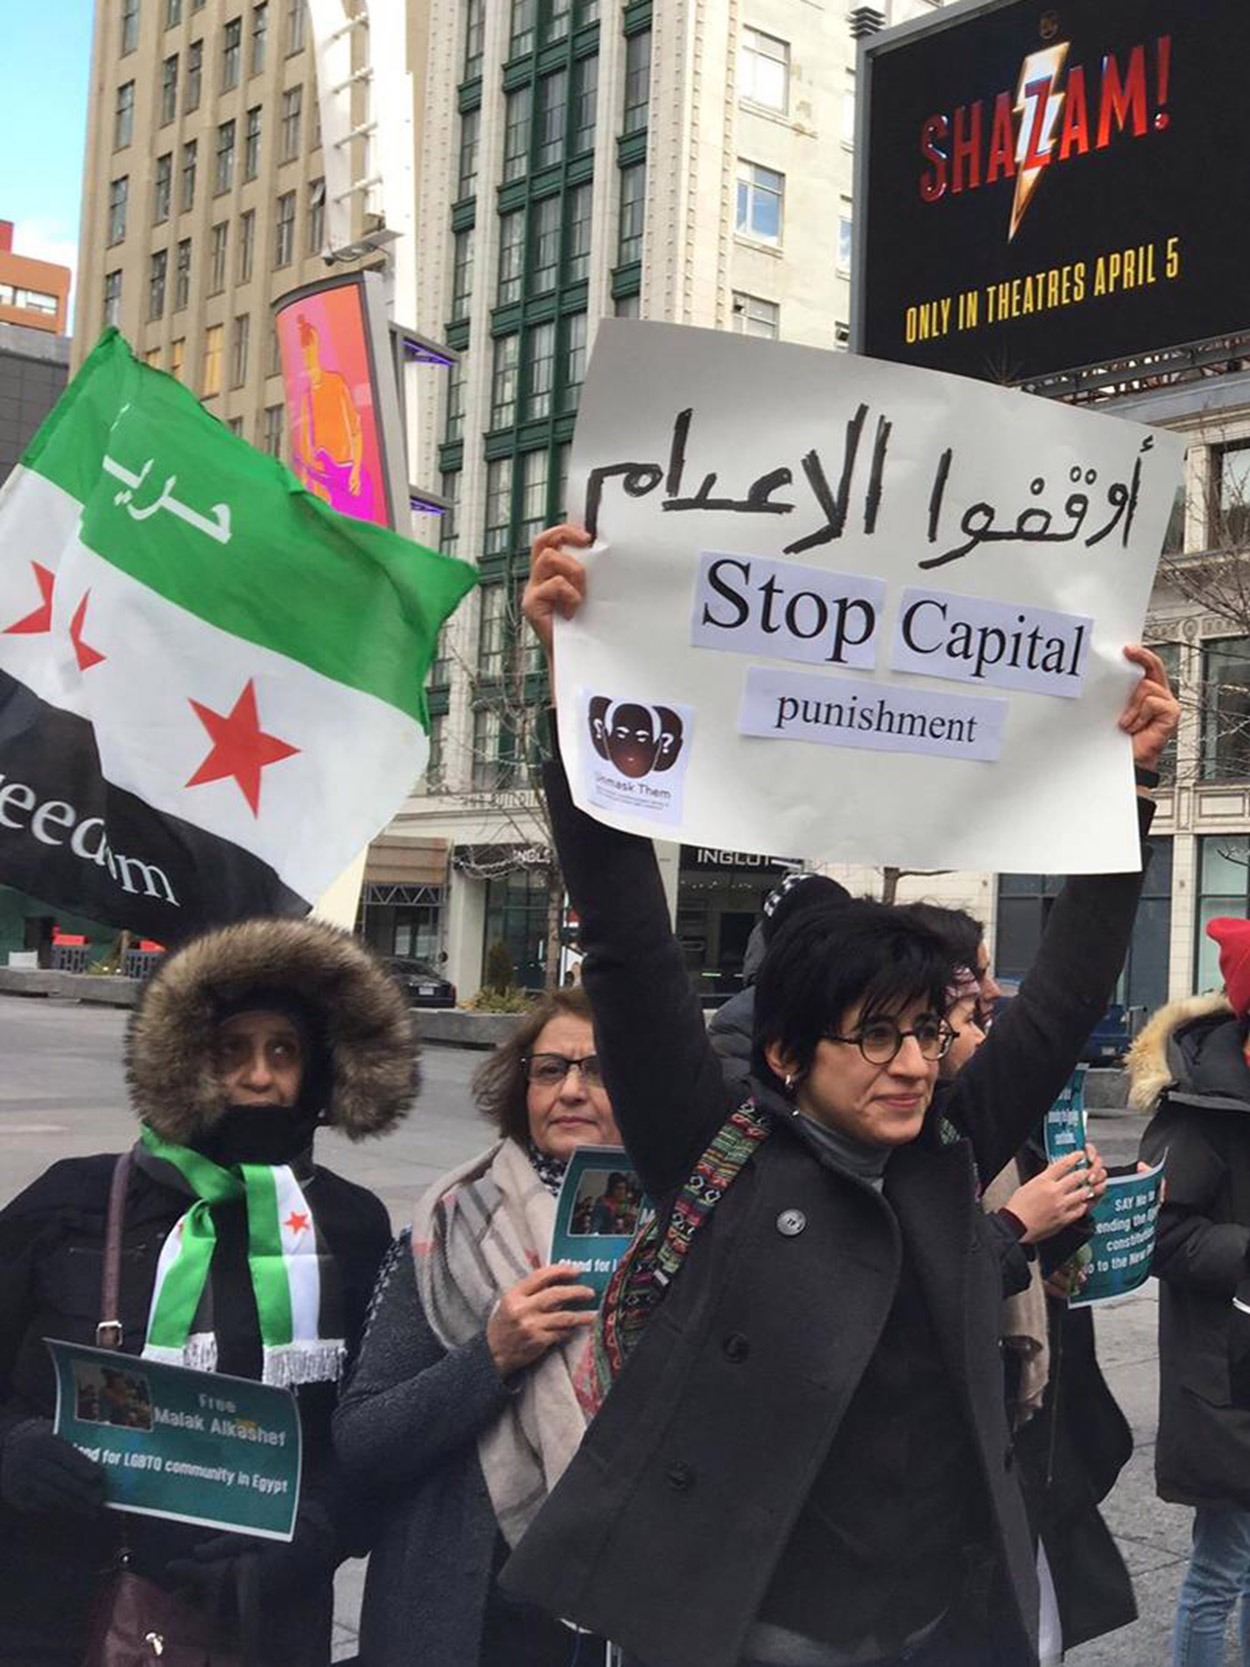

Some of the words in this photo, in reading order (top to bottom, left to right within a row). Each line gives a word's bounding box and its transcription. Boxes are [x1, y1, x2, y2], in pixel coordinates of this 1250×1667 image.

[919, 34, 1172, 202] SHAZAM!
[905, 297, 951, 344] ONLY
[957, 290, 978, 331] IN
[986, 262, 1086, 324] THEATRES
[1094, 243, 1156, 297] APRIL
[1166, 236, 1179, 278] 5
[702, 558, 876, 665] Stop
[901, 599, 1085, 678] Capital
[774, 695, 979, 743] punishment
[1114, 1195, 1134, 1212] SAY
[1094, 1218, 1131, 1233] ending
[594, 1257, 611, 1272] for
[198, 1393, 237, 1414] Free
[154, 1406, 205, 1432] Malak
[210, 1418, 288, 1447] Alkashef
[102, 1449, 121, 1465] for
[123, 1453, 162, 1472] LGBTQ
[165, 1458, 235, 1486] community
[237, 1471, 250, 1486] in
[252, 1474, 289, 1495] Egypt
